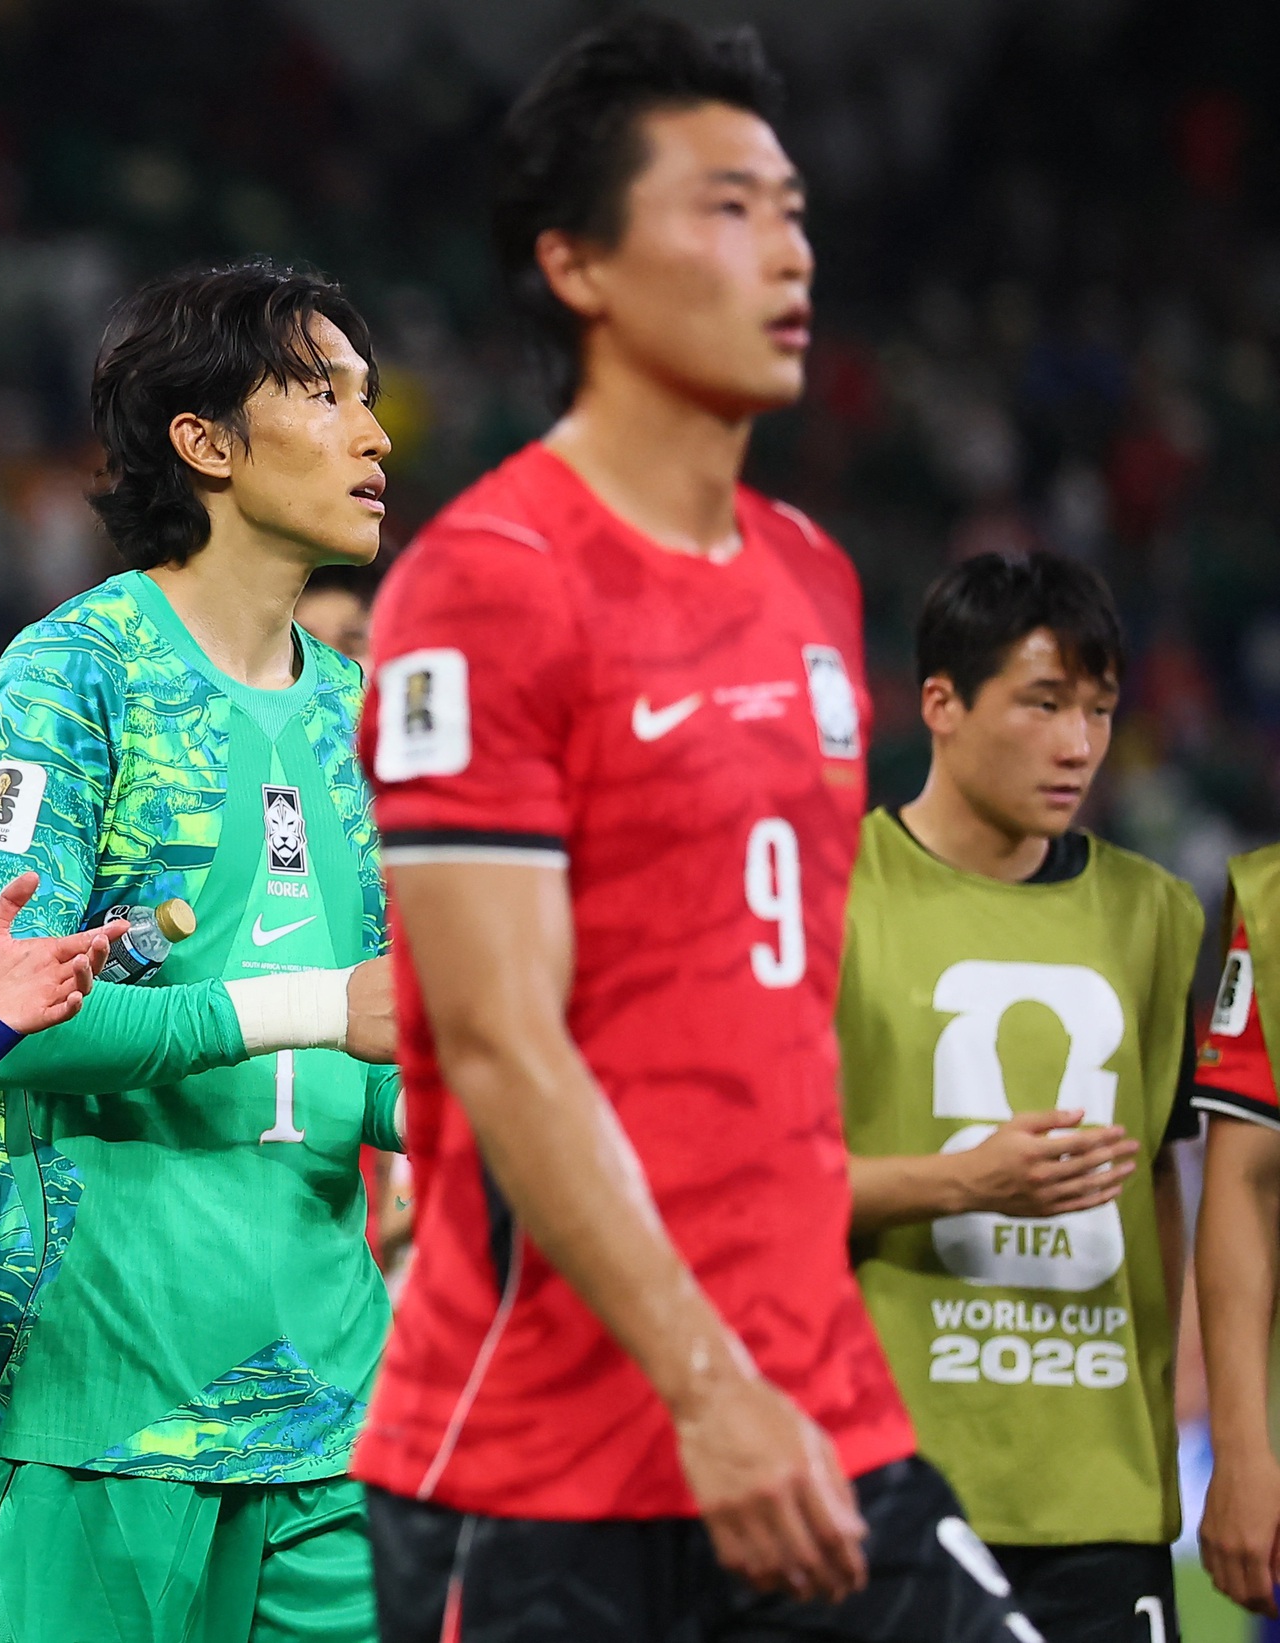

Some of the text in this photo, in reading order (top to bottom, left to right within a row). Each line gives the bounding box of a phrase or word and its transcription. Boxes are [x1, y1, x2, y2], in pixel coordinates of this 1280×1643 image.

[267, 880, 309, 898] KOREA
[744, 815, 807, 989] 9
[242, 961, 260, 969] SOUTH
[993, 1224, 1072, 1259] FIFA
[931, 1299, 1128, 1335] WORLD CUP
[929, 1333, 1128, 1389] 2026
